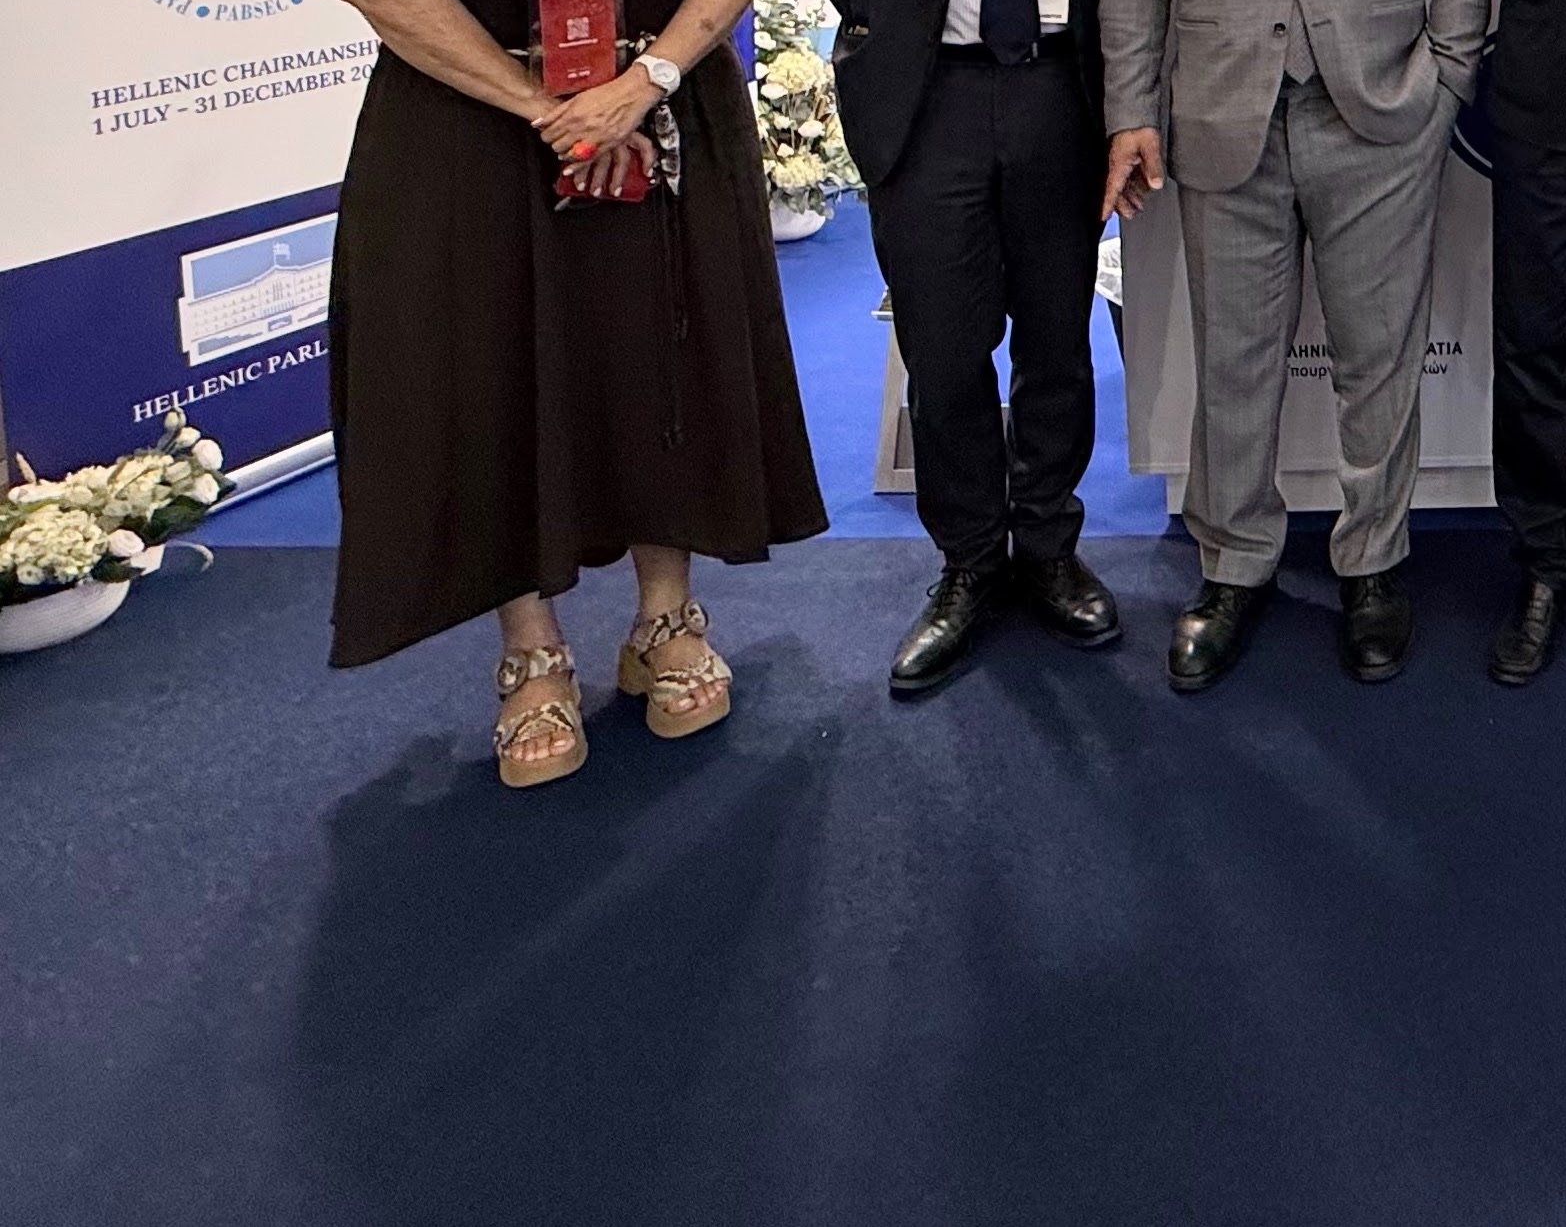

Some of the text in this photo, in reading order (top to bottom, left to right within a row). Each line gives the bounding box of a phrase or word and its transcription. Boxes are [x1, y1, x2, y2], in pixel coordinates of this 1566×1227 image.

[92, 39, 380, 109] HELLENIC CHAIRMANSHI
[93, 118, 104, 135] 1
[110, 104, 171, 133] JULY
[195, 94, 218, 114] 31
[224, 70, 346, 109] DECEMBER
[133, 340, 329, 423] HELLENIC PARL
[1425, 341, 1463, 355] ΑΤΙΑ
